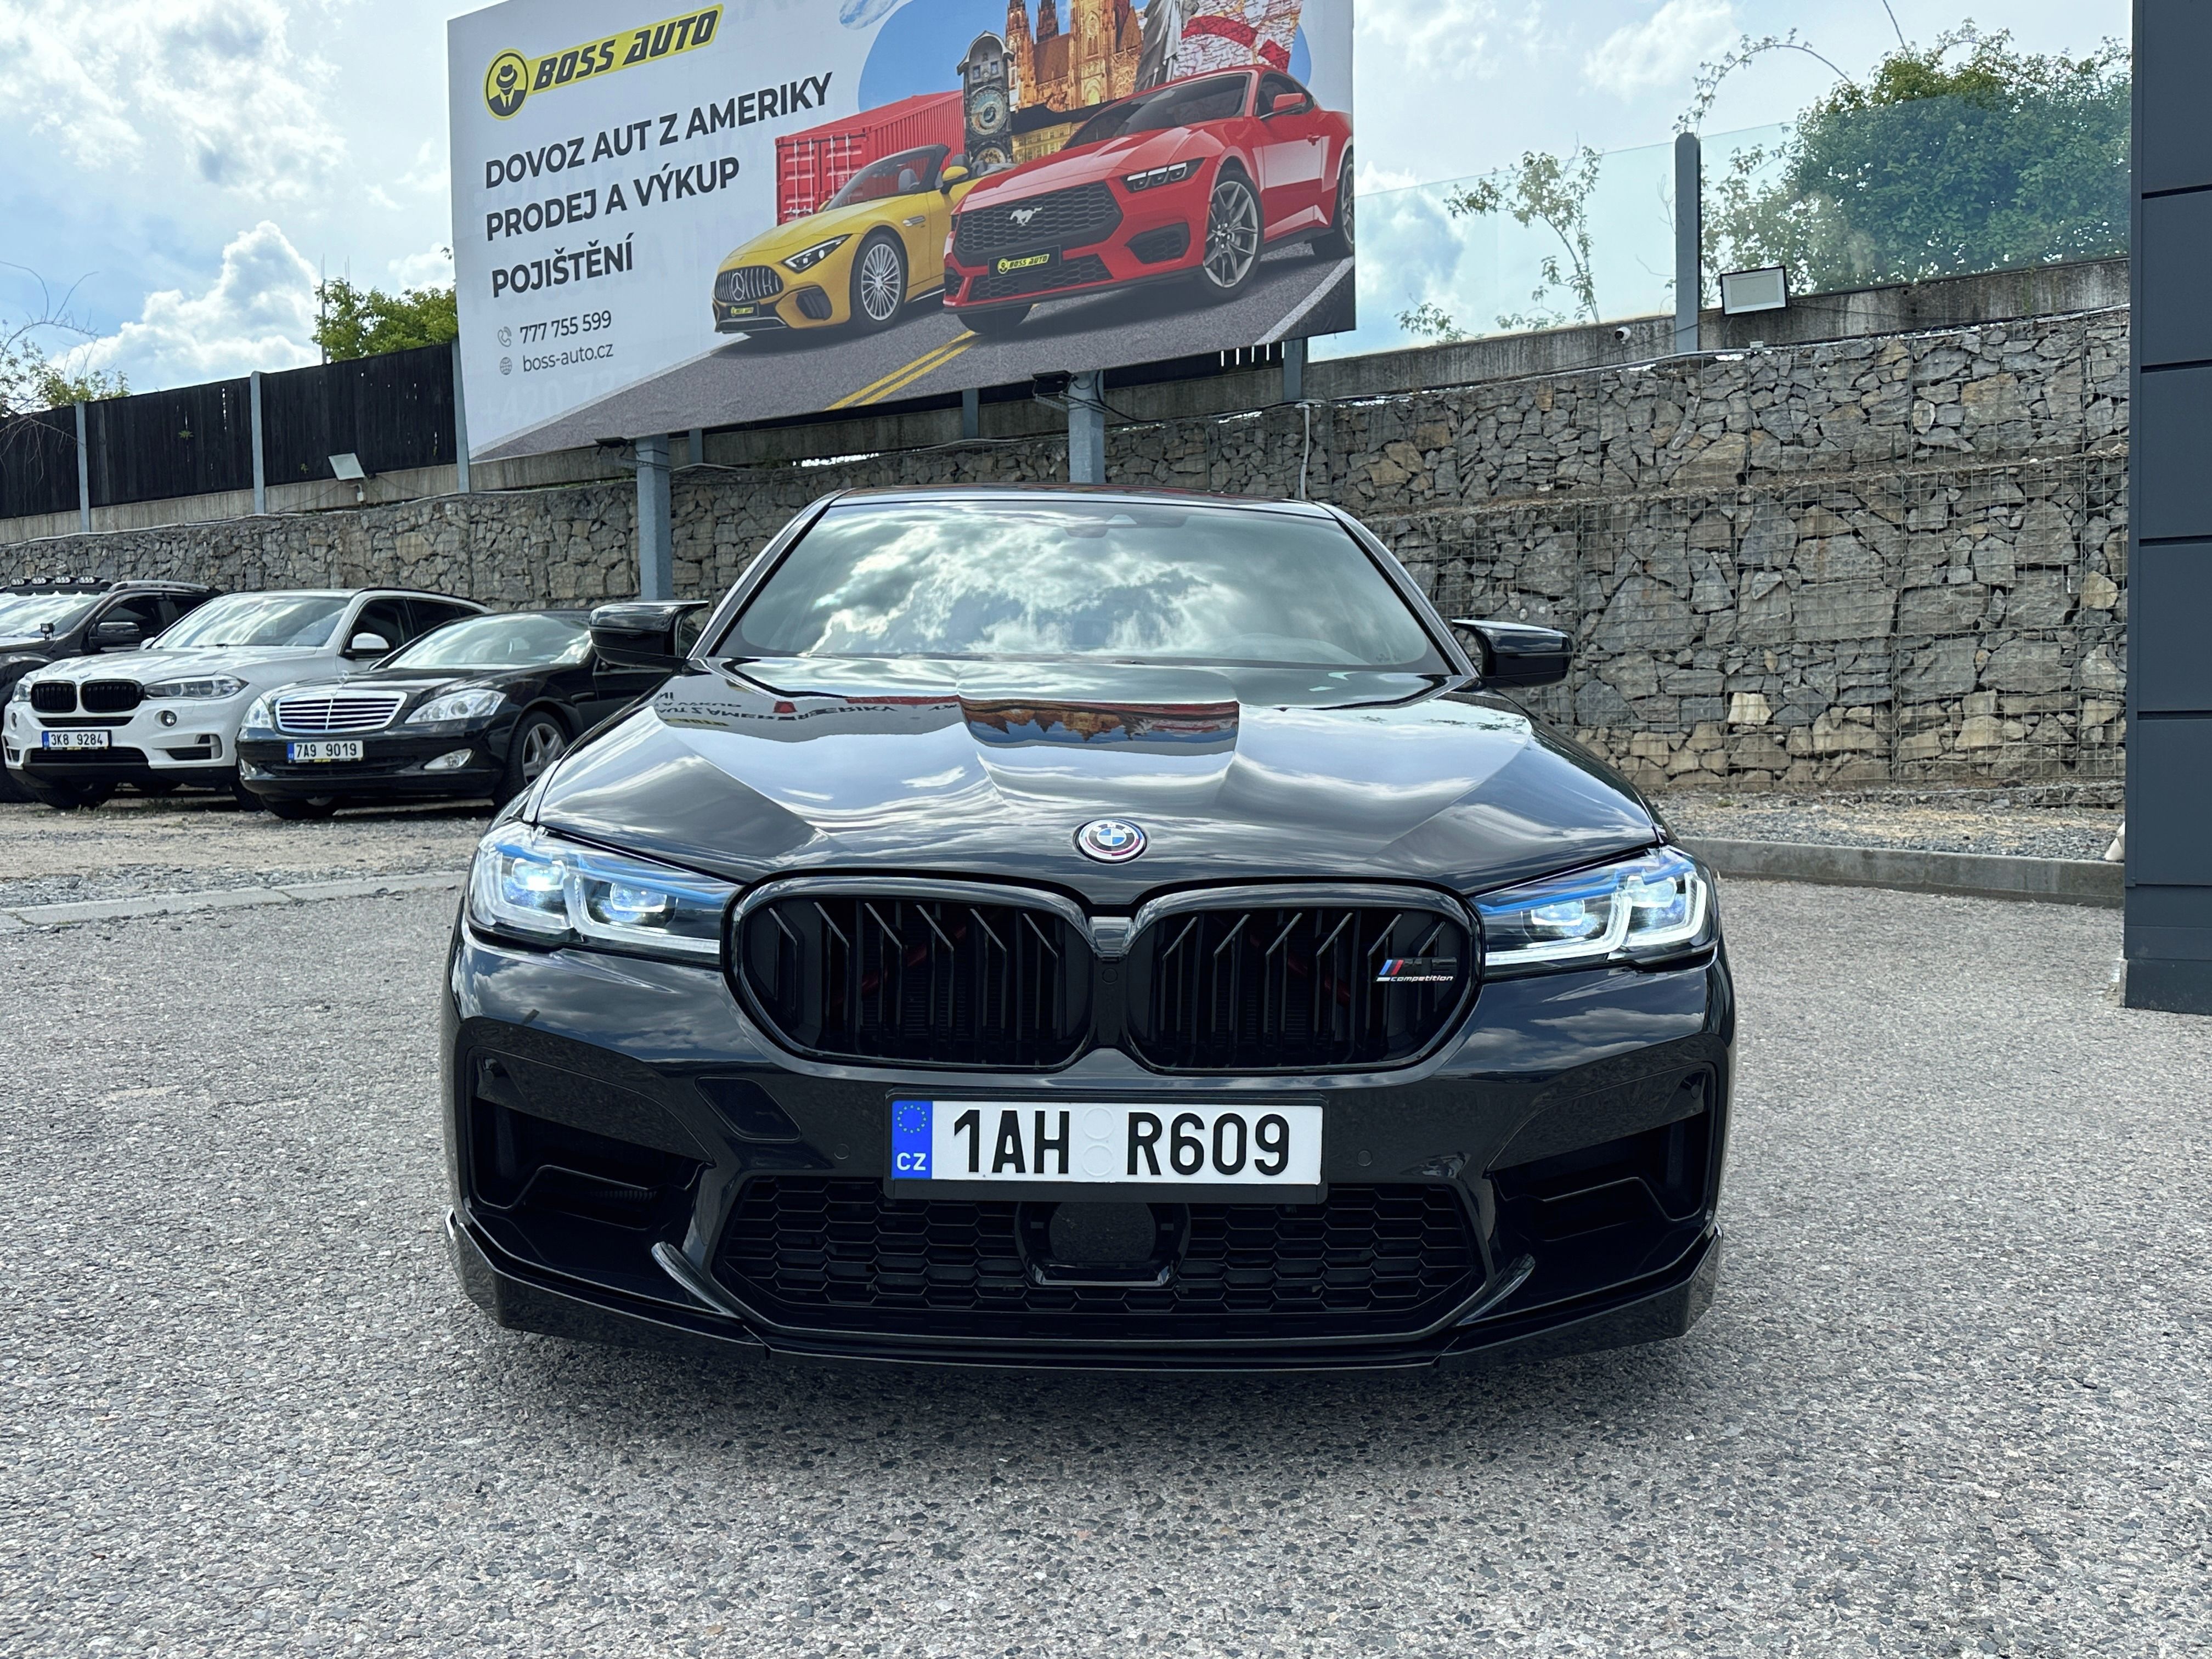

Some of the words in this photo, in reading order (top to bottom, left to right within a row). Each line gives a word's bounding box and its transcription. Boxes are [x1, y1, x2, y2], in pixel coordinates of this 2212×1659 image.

[533, 40, 616, 91] BOSS
[622, 10, 718, 65] AUTO
[486, 137, 585, 189] DOVOZ
[591, 120, 652, 162] AUT
[659, 114, 678, 146] Z
[685, 72, 833, 140] AMERIKY
[487, 189, 596, 241] PRODEJ
[605, 184, 627, 215] A
[634, 157, 740, 207] VÝKUP
[492, 232, 634, 297] POJIŠTĚNÍ
[1029, 255, 1048, 264] AUTO
[520, 322, 547, 344] 777
[551, 316, 578, 338] 755
[582, 310, 612, 331] 599
[523, 344, 613, 372] boss-auto.cz
[51, 733, 69, 746] 3K8
[77, 733, 103, 745] 9284
[296, 744, 316, 758] 7A9
[326, 743, 357, 756] 9019
[897, 1152, 927, 1171] CZ
[953, 1109, 1070, 1174] 1AH
[1127, 1111, 1290, 1176] R609
